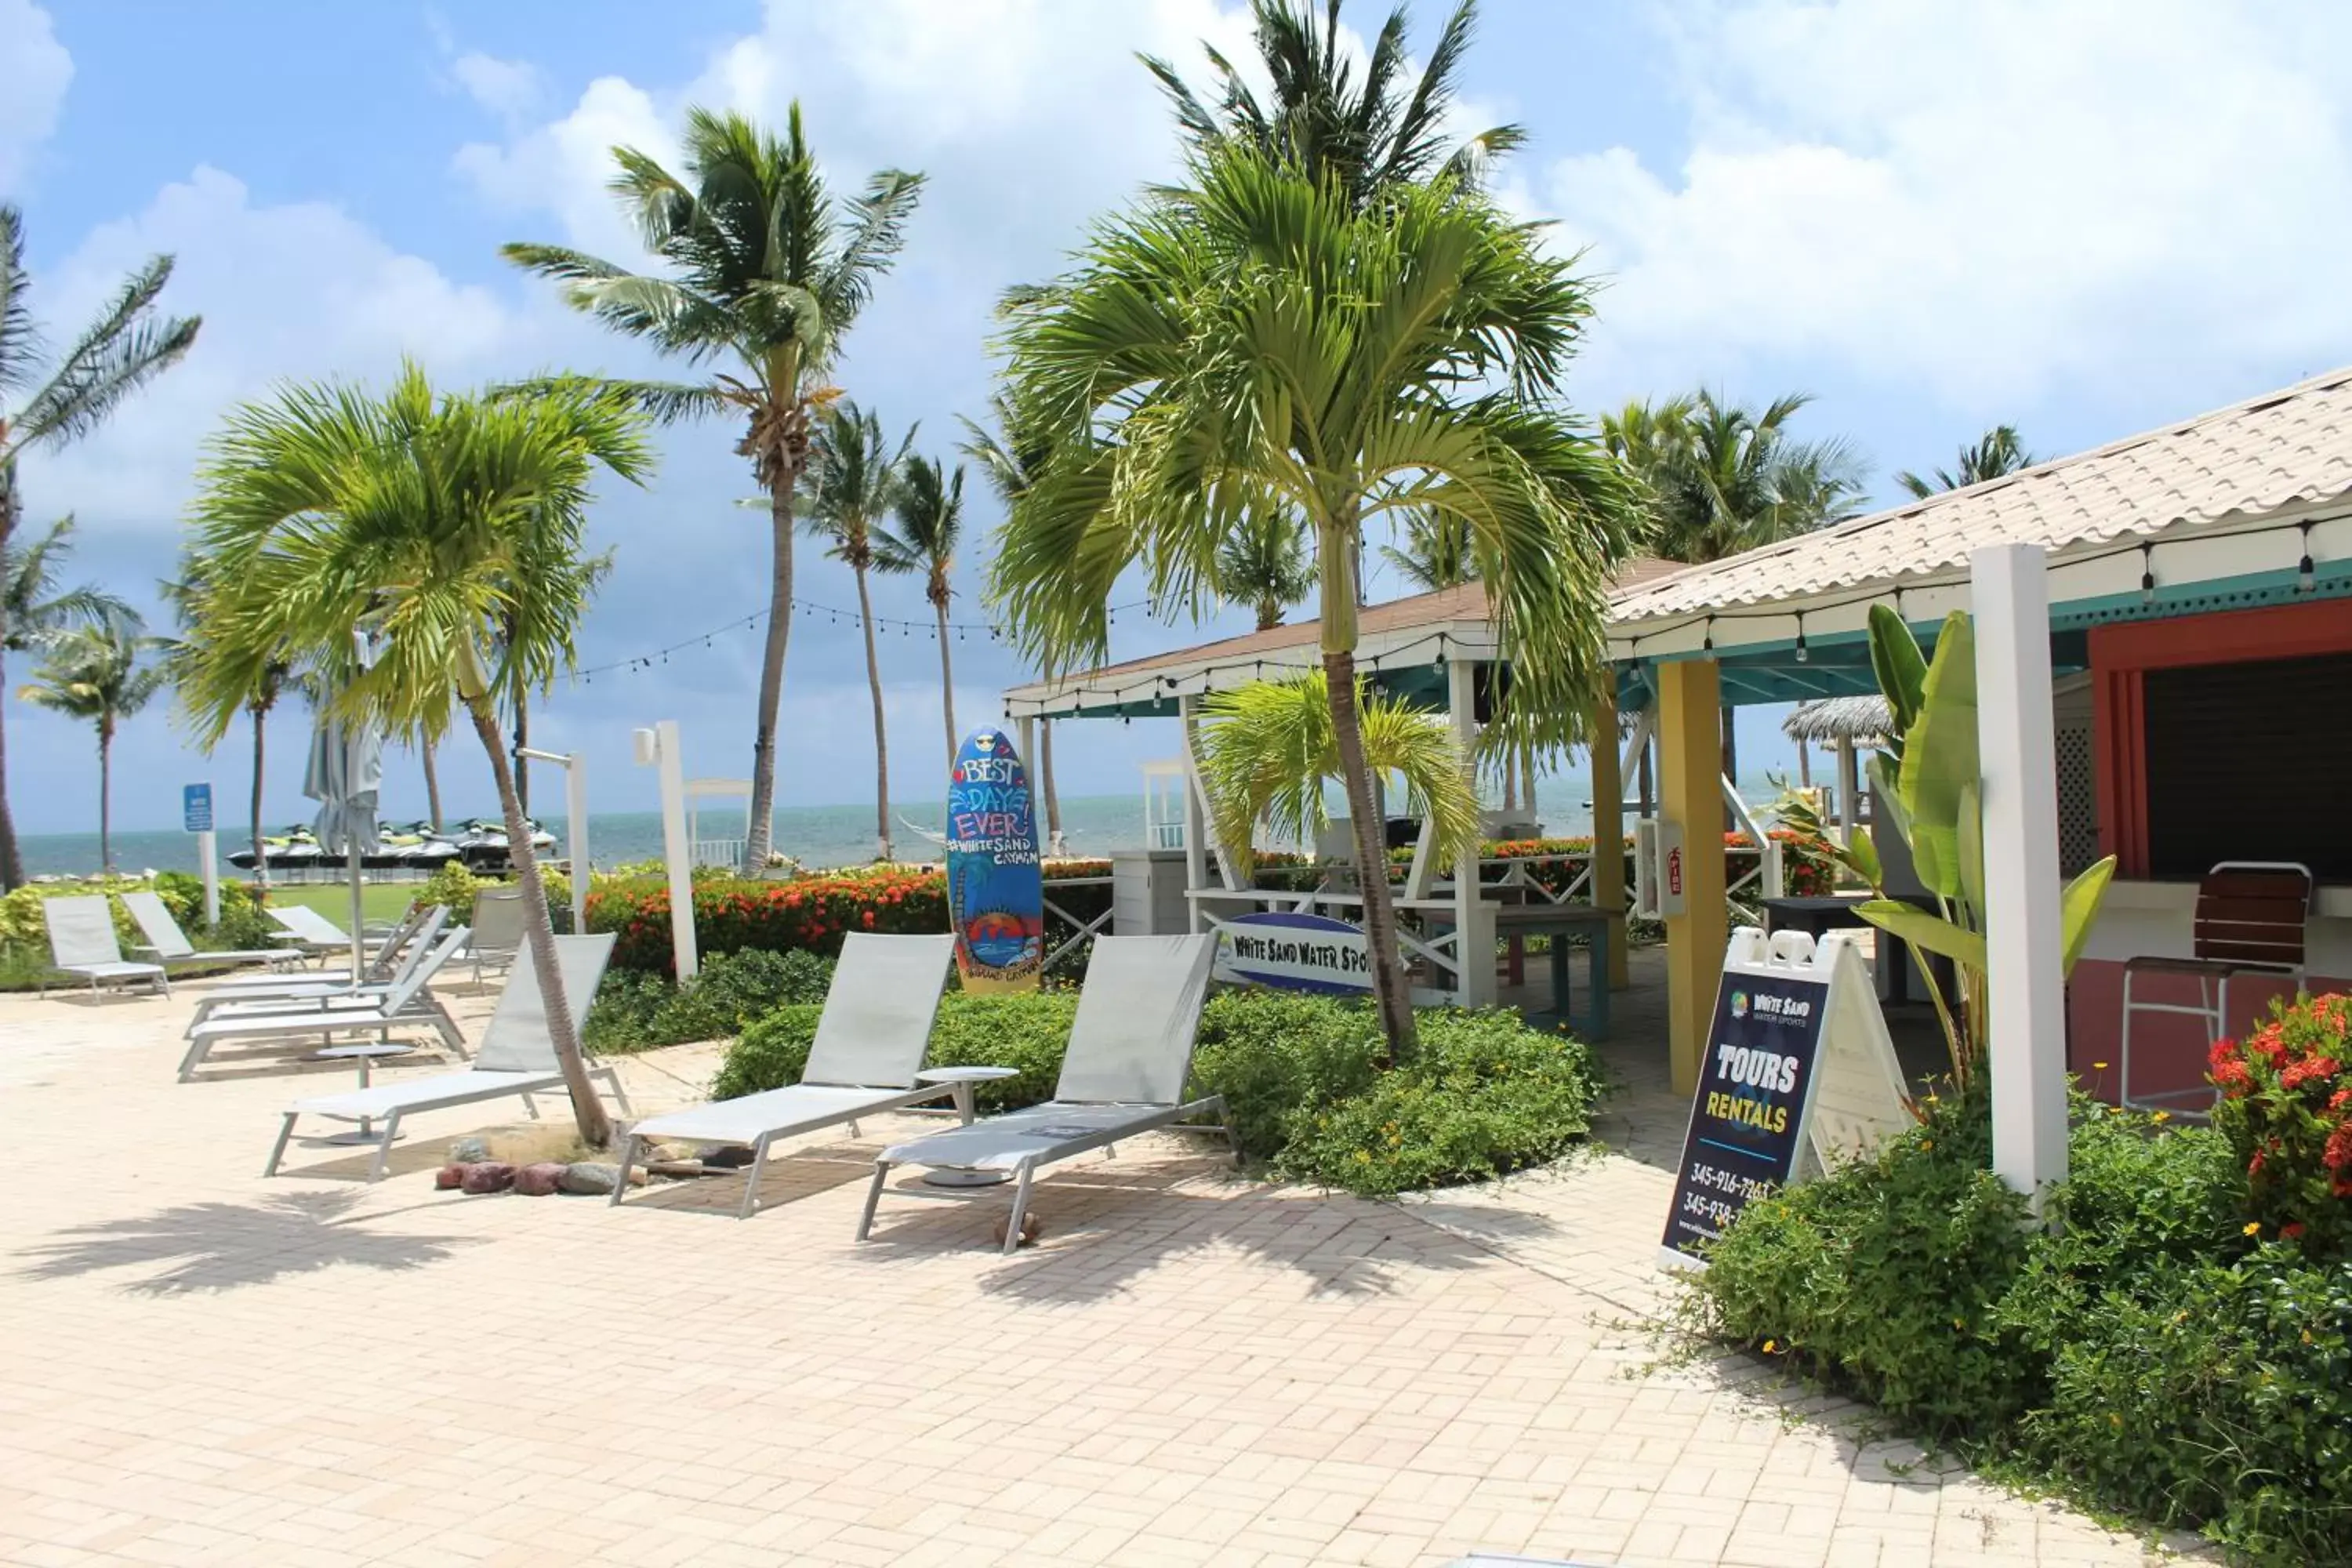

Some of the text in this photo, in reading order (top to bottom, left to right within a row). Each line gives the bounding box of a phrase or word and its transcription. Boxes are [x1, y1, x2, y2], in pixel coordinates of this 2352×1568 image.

[963, 757, 1022, 786] BEST
[967, 787, 1014, 812] DAY
[953, 801, 1029, 839] EVER!
[993, 851, 1039, 866] CAYMAN
[1234, 935, 1371, 973] WHiTE SAND WATER SPO
[1754, 994, 1810, 1017] WHiTE SAND
[1718, 1044, 1798, 1094] TOURS
[1706, 1091, 1787, 1134] RENTALS
